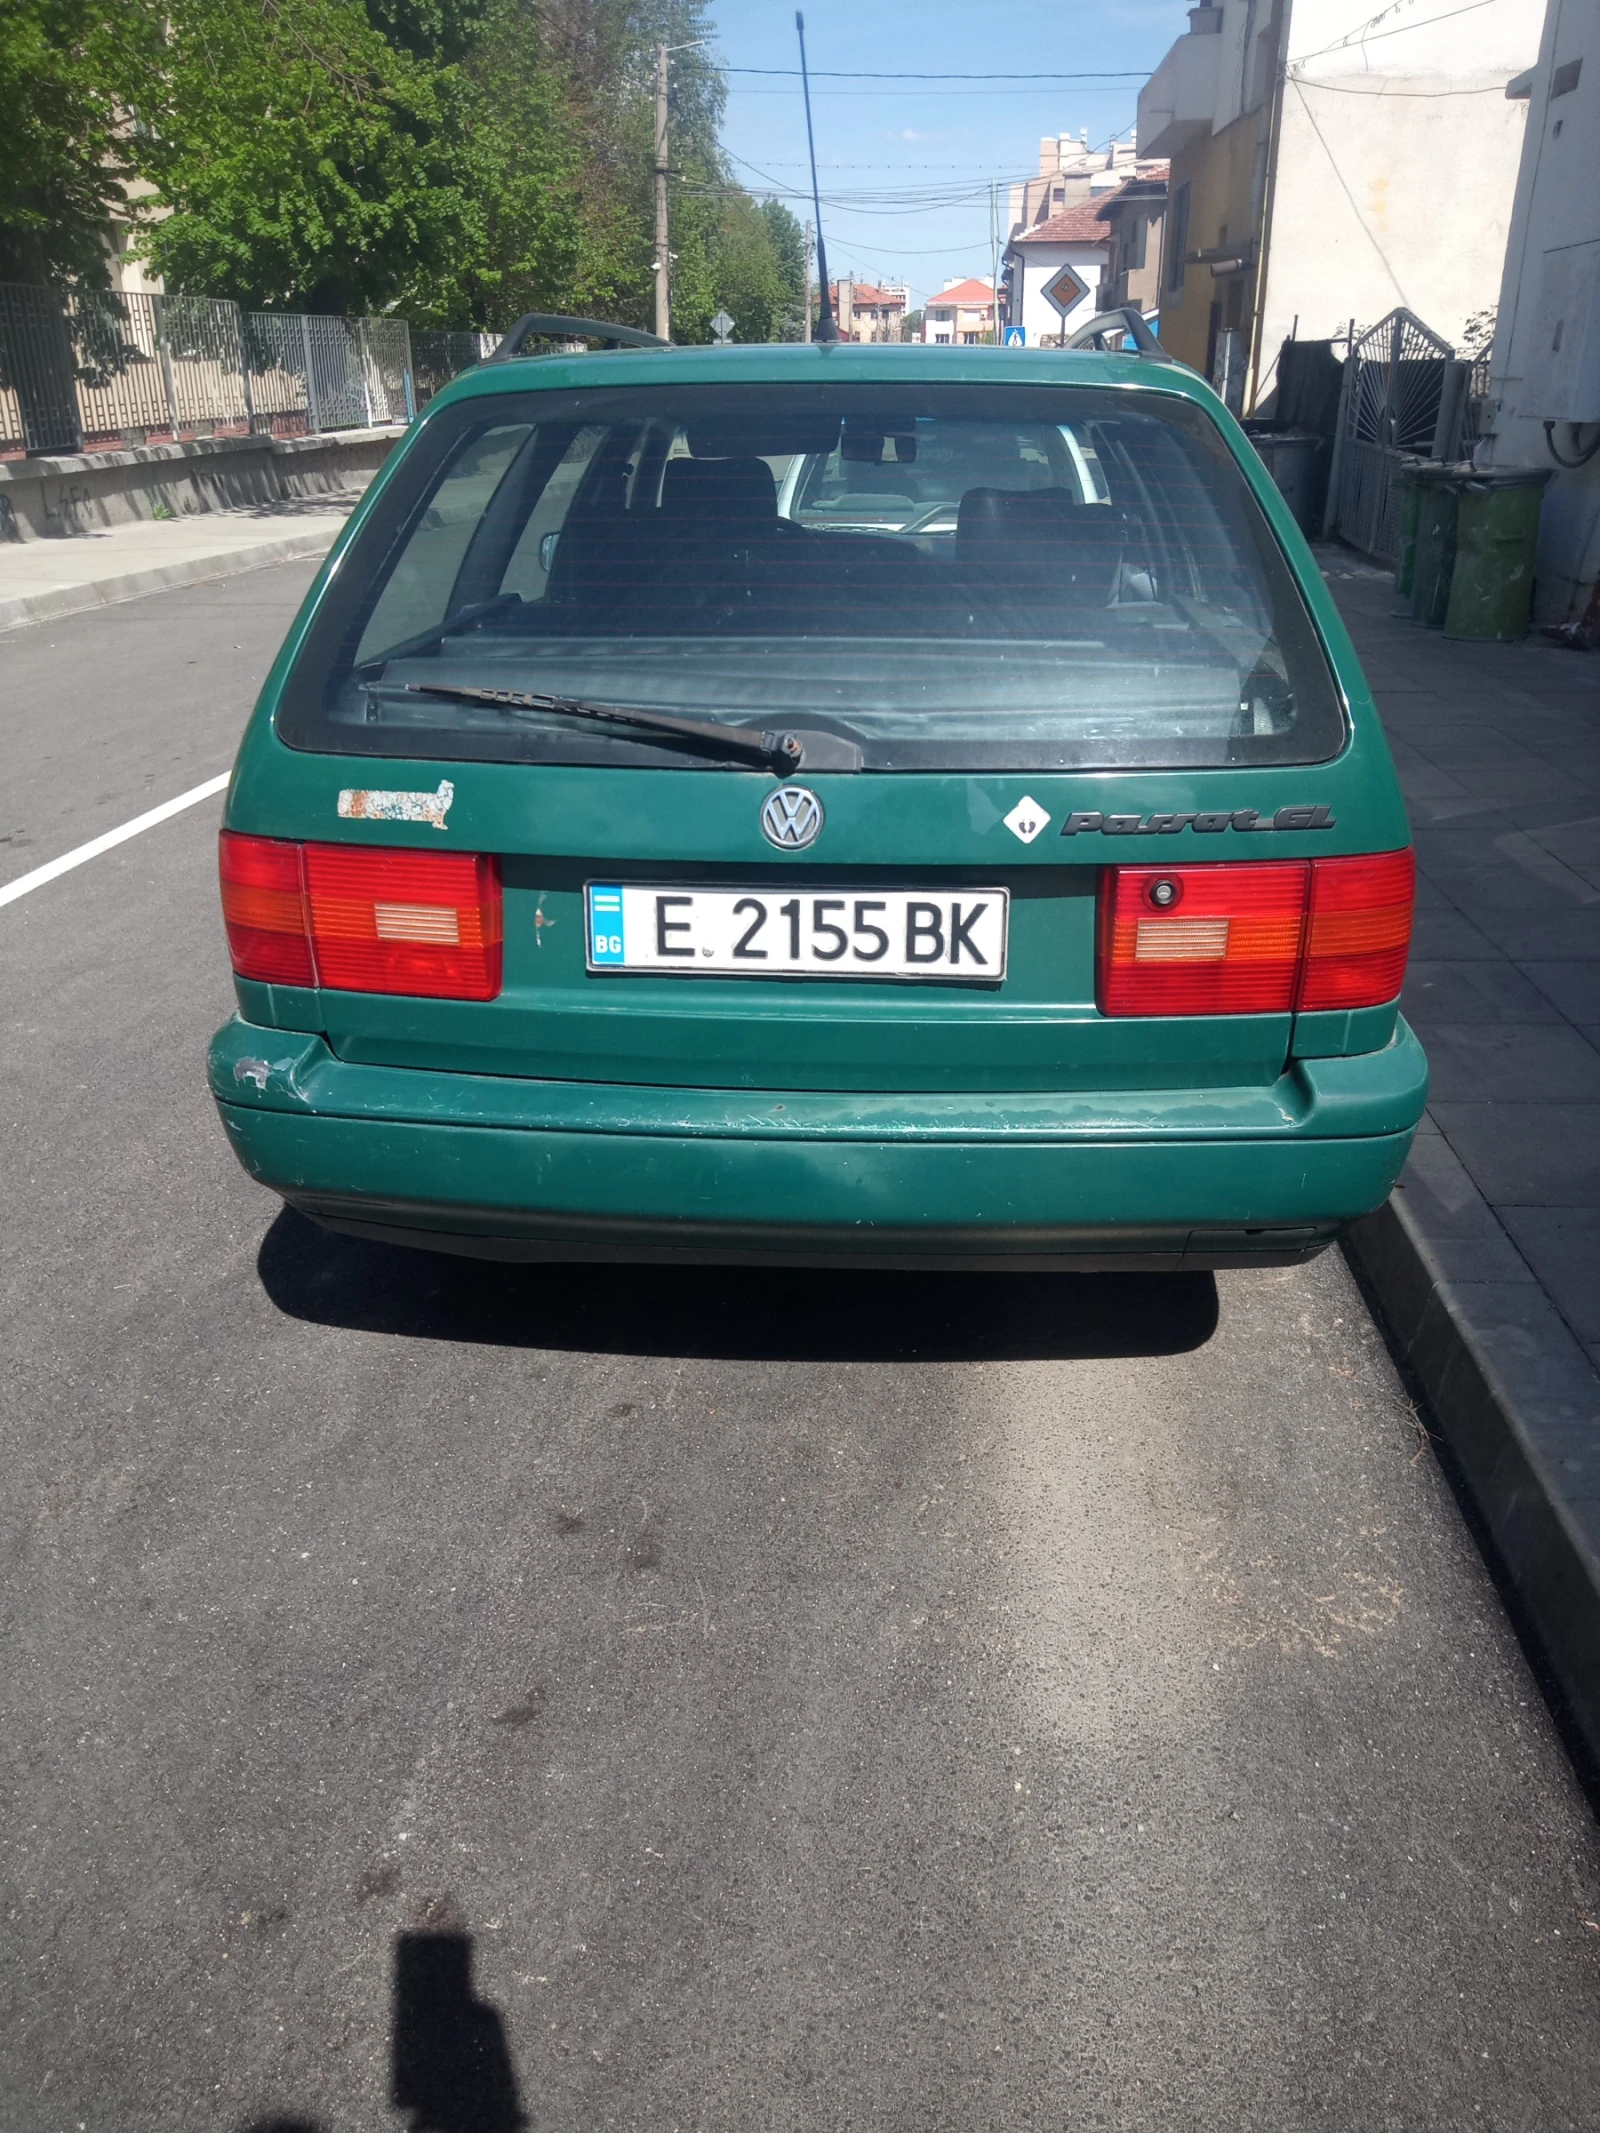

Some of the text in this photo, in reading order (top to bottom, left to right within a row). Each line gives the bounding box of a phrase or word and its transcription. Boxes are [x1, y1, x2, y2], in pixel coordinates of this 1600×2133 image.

[763, 786, 820, 845] VW
[1060, 805, 1337, 836] Passat GL
[595, 935, 622, 954] BG
[655, 896, 989, 966] E 2155 BK
